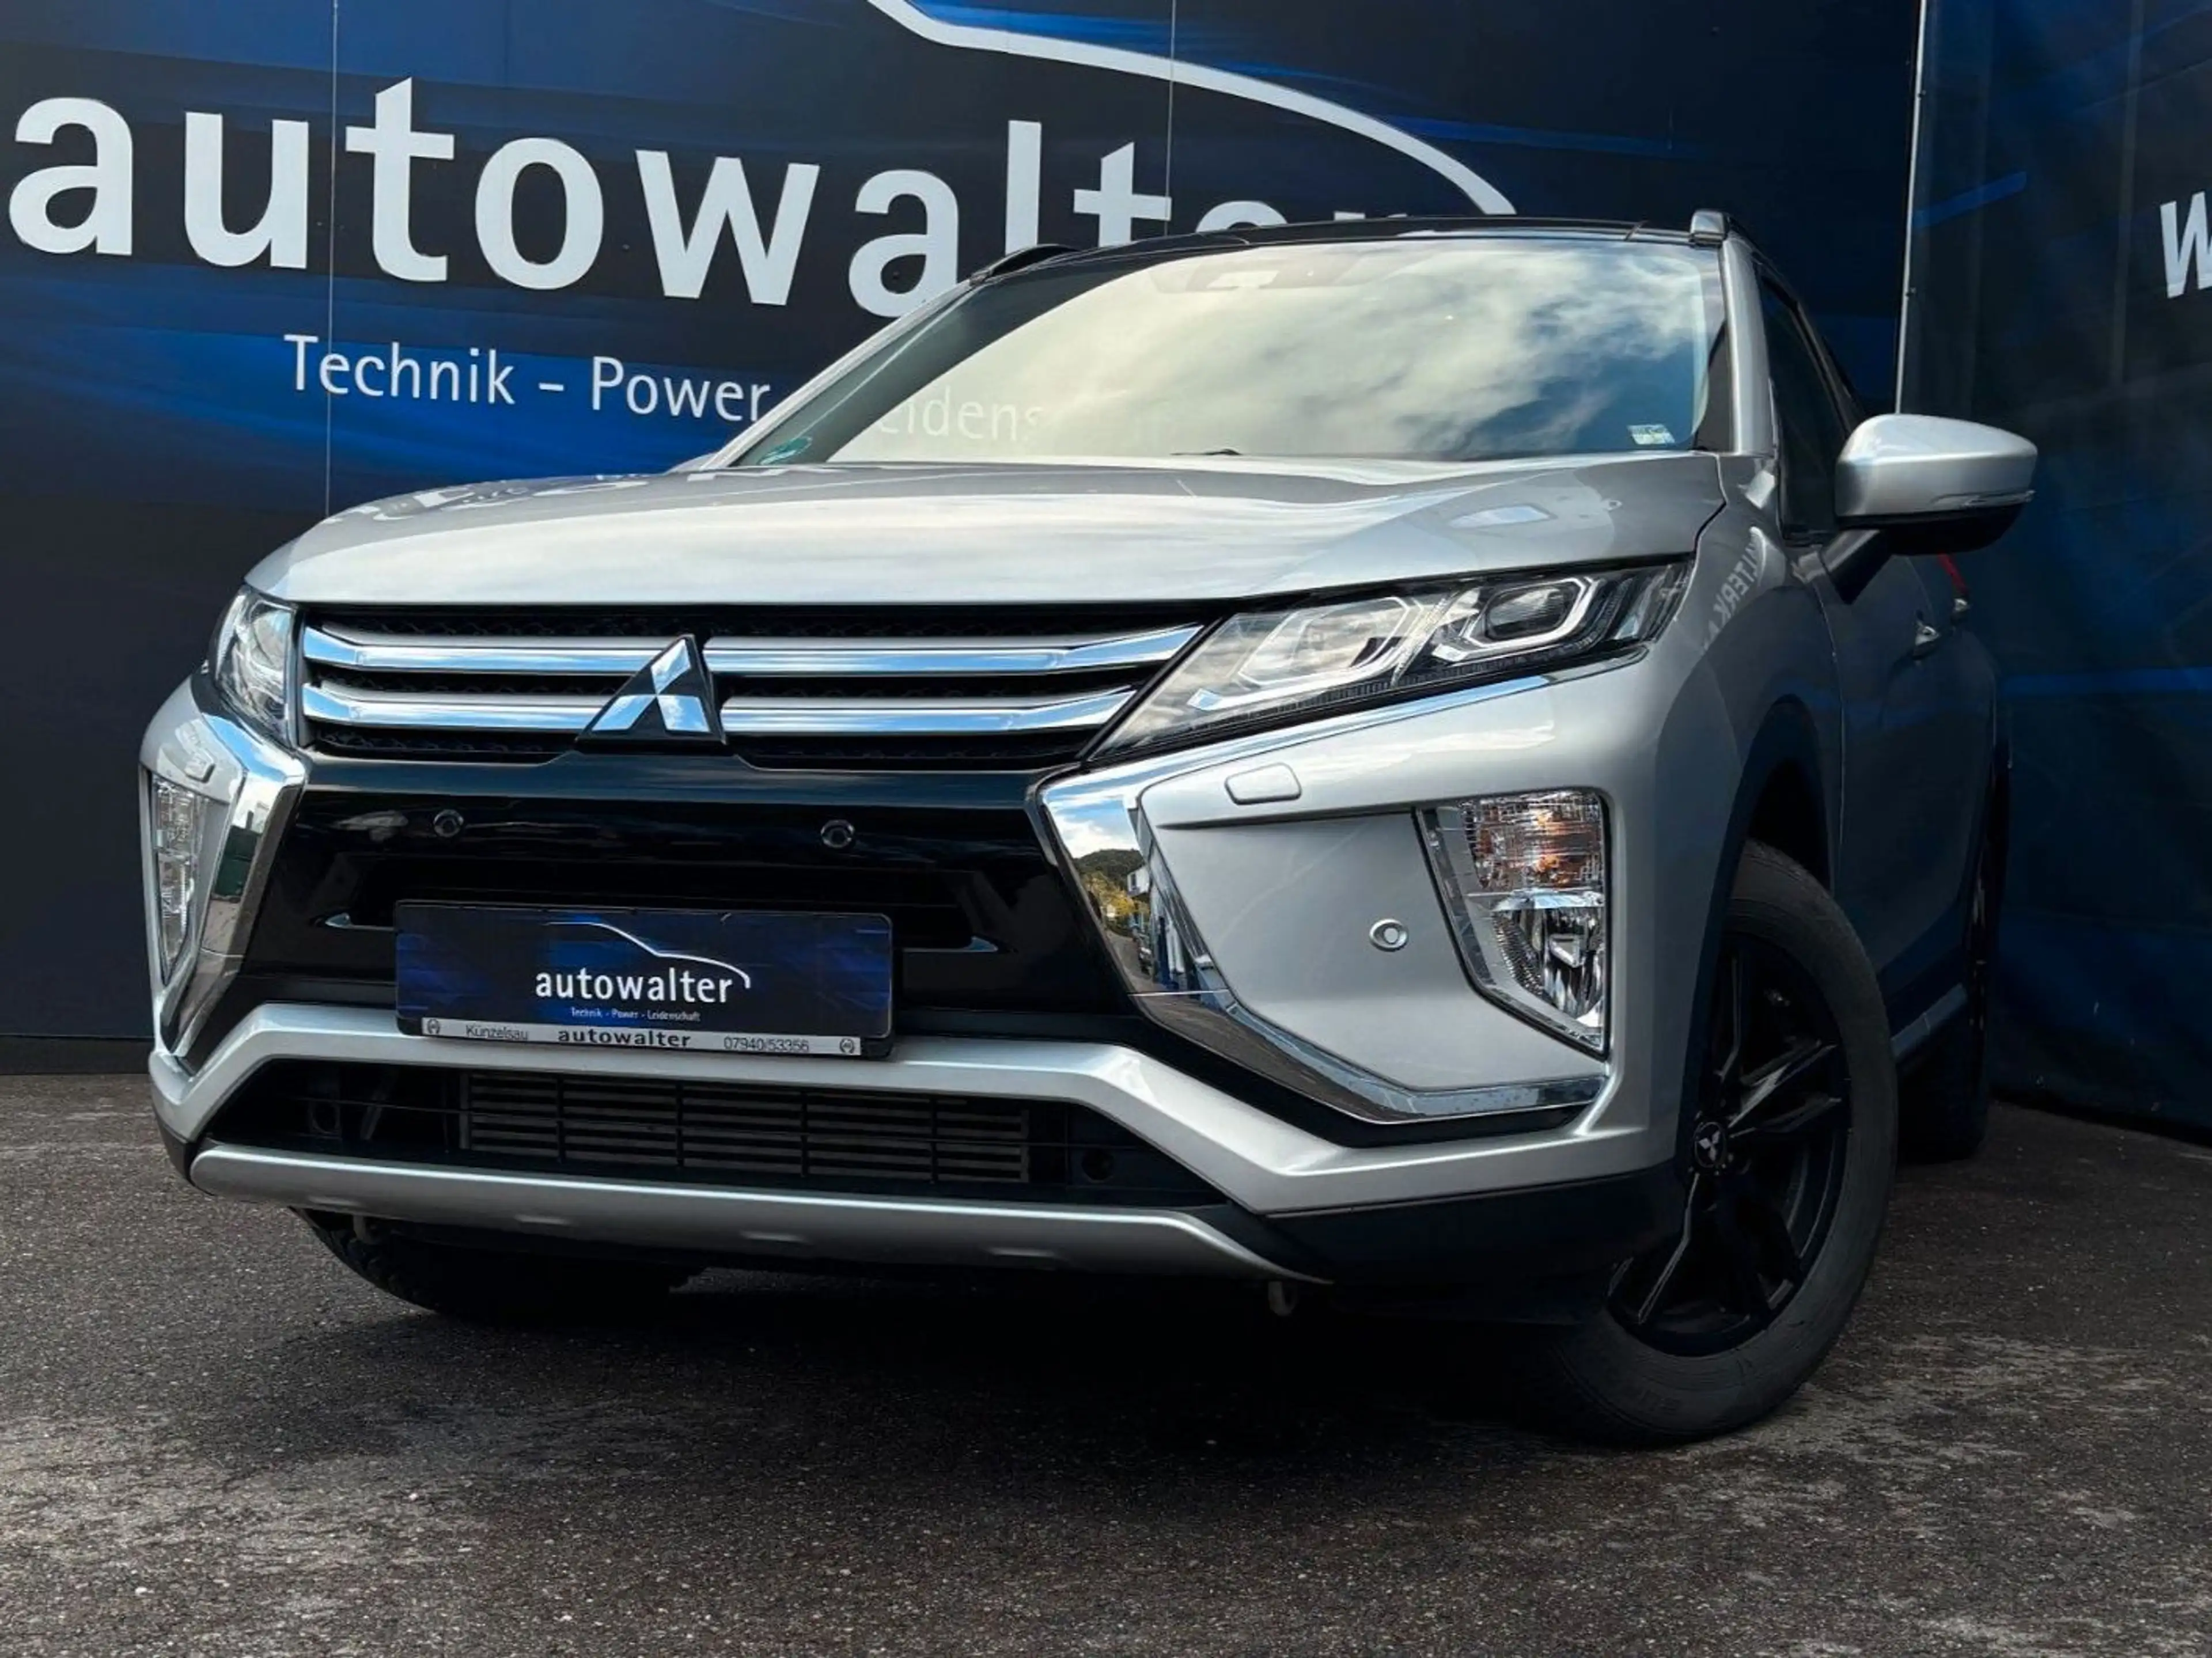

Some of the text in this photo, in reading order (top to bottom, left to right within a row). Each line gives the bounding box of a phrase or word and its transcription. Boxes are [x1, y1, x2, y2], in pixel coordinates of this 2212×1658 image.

[283, 334, 516, 405] Technik
[592, 356, 771, 422] Power
[535, 967, 733, 1003] autowalter
[571, 1007, 603, 1018] Technik
[465, 1025, 529, 1041] Künzelsau
[558, 1029, 691, 1047] autowalter
